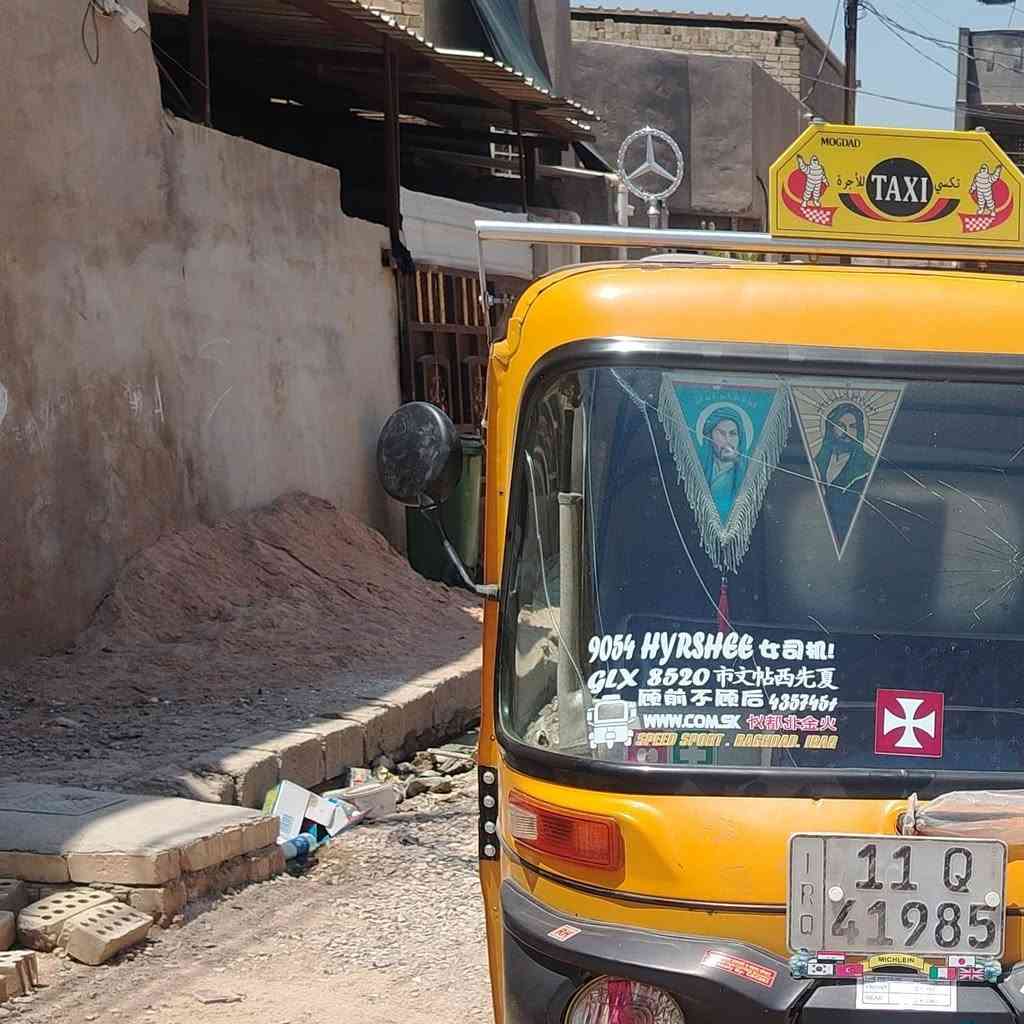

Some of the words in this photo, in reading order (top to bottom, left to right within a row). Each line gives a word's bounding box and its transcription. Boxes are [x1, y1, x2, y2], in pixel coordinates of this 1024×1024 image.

[820, 136, 861, 148] MOGDAD
[871, 174, 928, 203] TAXI
[934, 177, 961, 193] تكسي
[588, 633, 636, 663] 9054
[587, 667, 640, 695] GLX
[647, 666, 710, 687] 8520
[855, 843, 918, 891] 11
[943, 846, 974, 893] Q
[799, 851, 816, 936] IRQ
[831, 899, 997, 949] 41985
